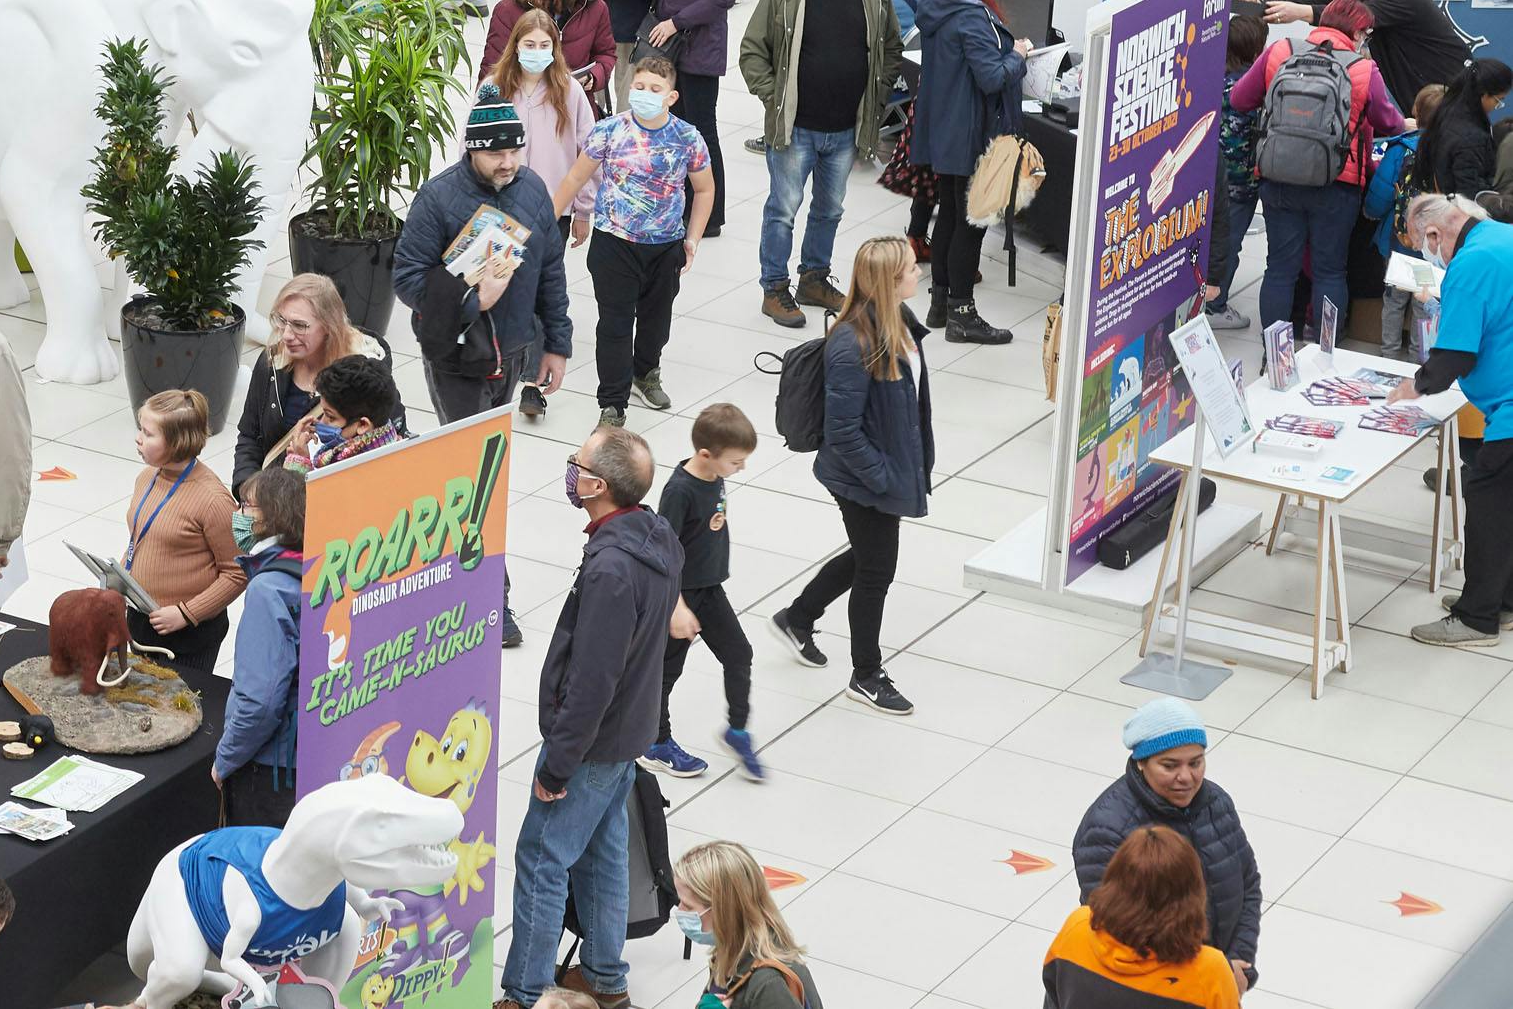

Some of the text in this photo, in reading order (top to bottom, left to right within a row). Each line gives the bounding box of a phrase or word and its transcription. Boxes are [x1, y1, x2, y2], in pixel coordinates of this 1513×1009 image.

[1116, 9, 1186, 78] NORWICH
[1110, 79, 1179, 147] FESTIVAL
[1113, 47, 1176, 112] SCIENCE
[1132, 122, 1162, 150] OCTOBER
[1163, 110, 1178, 133] 2021
[1100, 189, 1209, 291] EXPLORIUM!
[1105, 187, 1141, 247] THE
[309, 431, 507, 608] ROARR!
[352, 560, 452, 616] DINOSAUR ADVENTURE
[306, 601, 467, 713] IT'S TIME YOU
[320, 616, 487, 727] CAME-N-SAURUS
